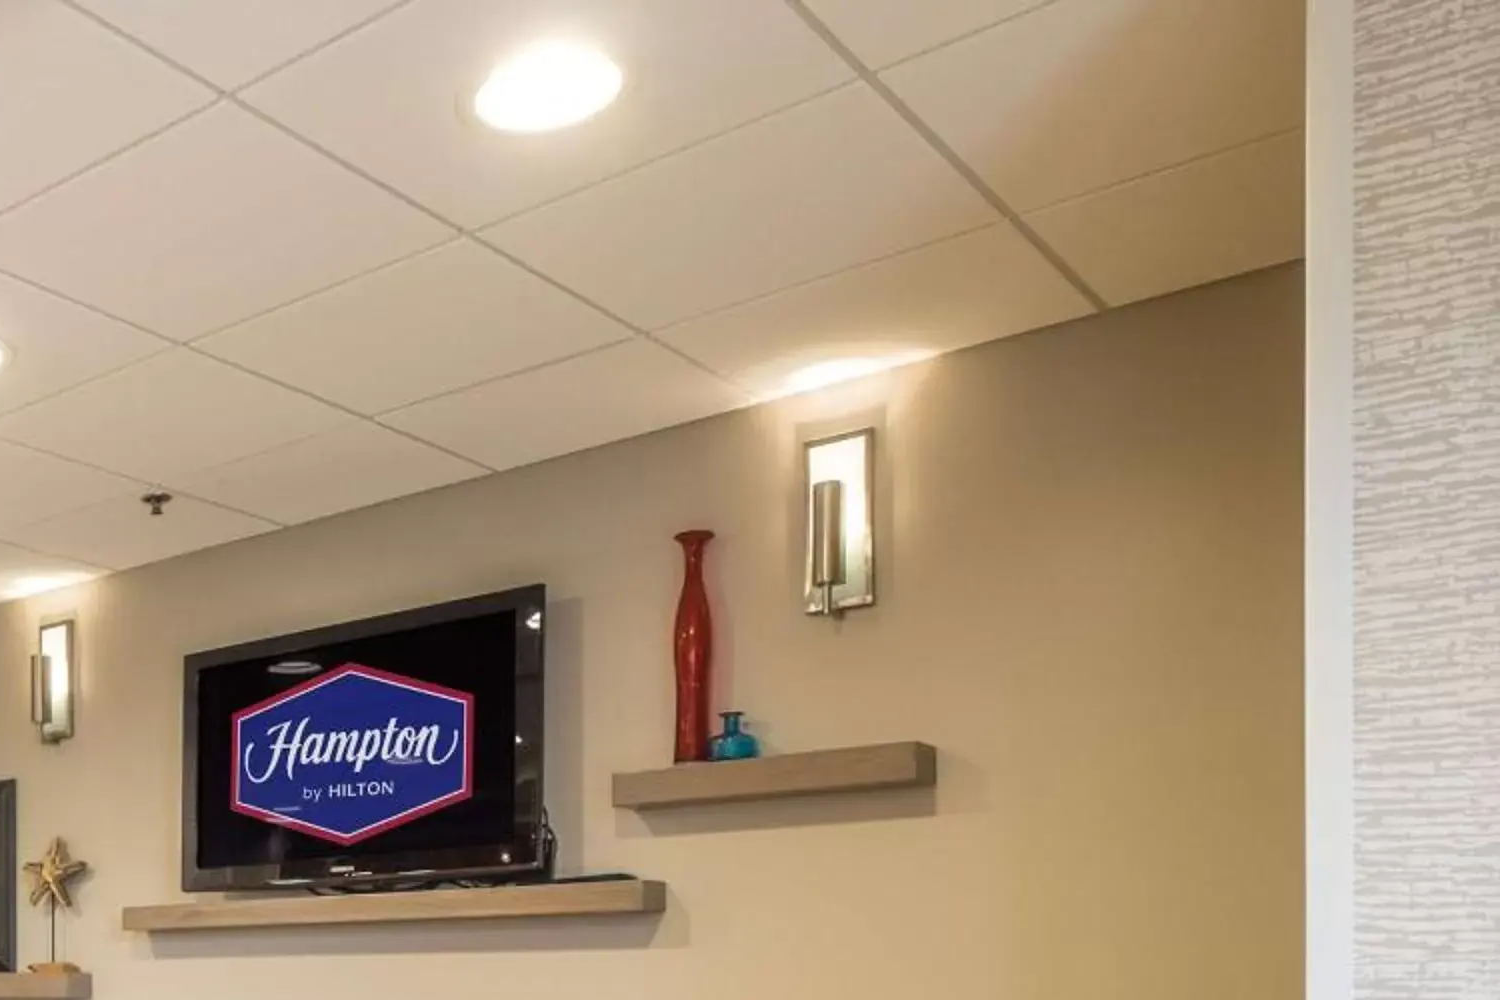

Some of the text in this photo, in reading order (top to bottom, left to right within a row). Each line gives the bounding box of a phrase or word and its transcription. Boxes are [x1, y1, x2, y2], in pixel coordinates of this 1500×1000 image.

[245, 716, 459, 783] Hampton
[303, 781, 394, 802] by HILTON
